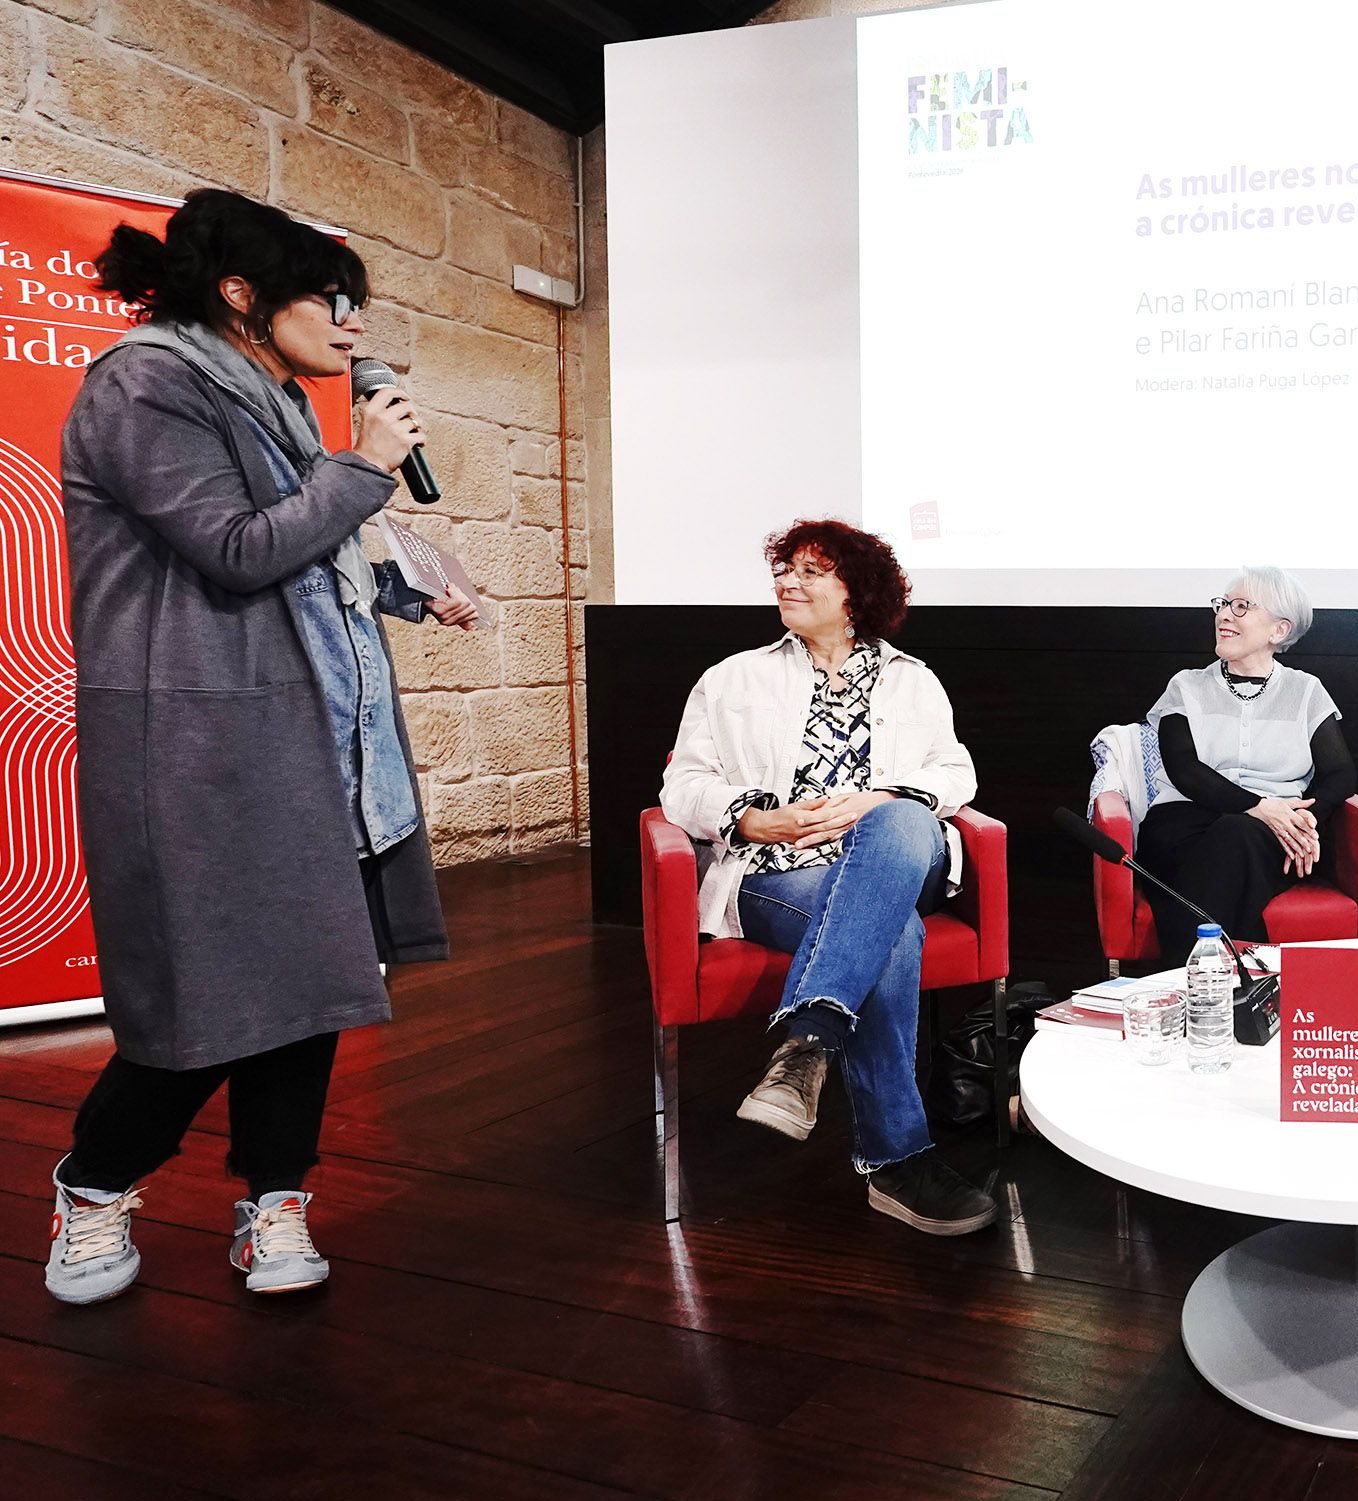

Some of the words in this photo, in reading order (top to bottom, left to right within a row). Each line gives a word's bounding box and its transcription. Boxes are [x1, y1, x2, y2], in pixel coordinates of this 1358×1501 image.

[907, 66, 1028, 114] FEMI-
[907, 105, 1034, 156] NISTA
[1135, 173, 1173, 200] As
[1180, 164, 1316, 197] mulleres
[1135, 214, 1153, 237] a
[1160, 201, 1275, 236] crónica
[46, 250, 100, 279] do
[1135, 292, 1185, 315] Ana
[1195, 280, 1296, 312] Romaní
[2, 324, 93, 368] ida
[1135, 335, 1152, 355] e
[1160, 327, 1213, 354] Pilar
[1222, 324, 1298, 351] Fariña
[1292, 1008, 1315, 1023] As
[1292, 1061, 1353, 1080] galego:
[1292, 1079, 1306, 1095] A
